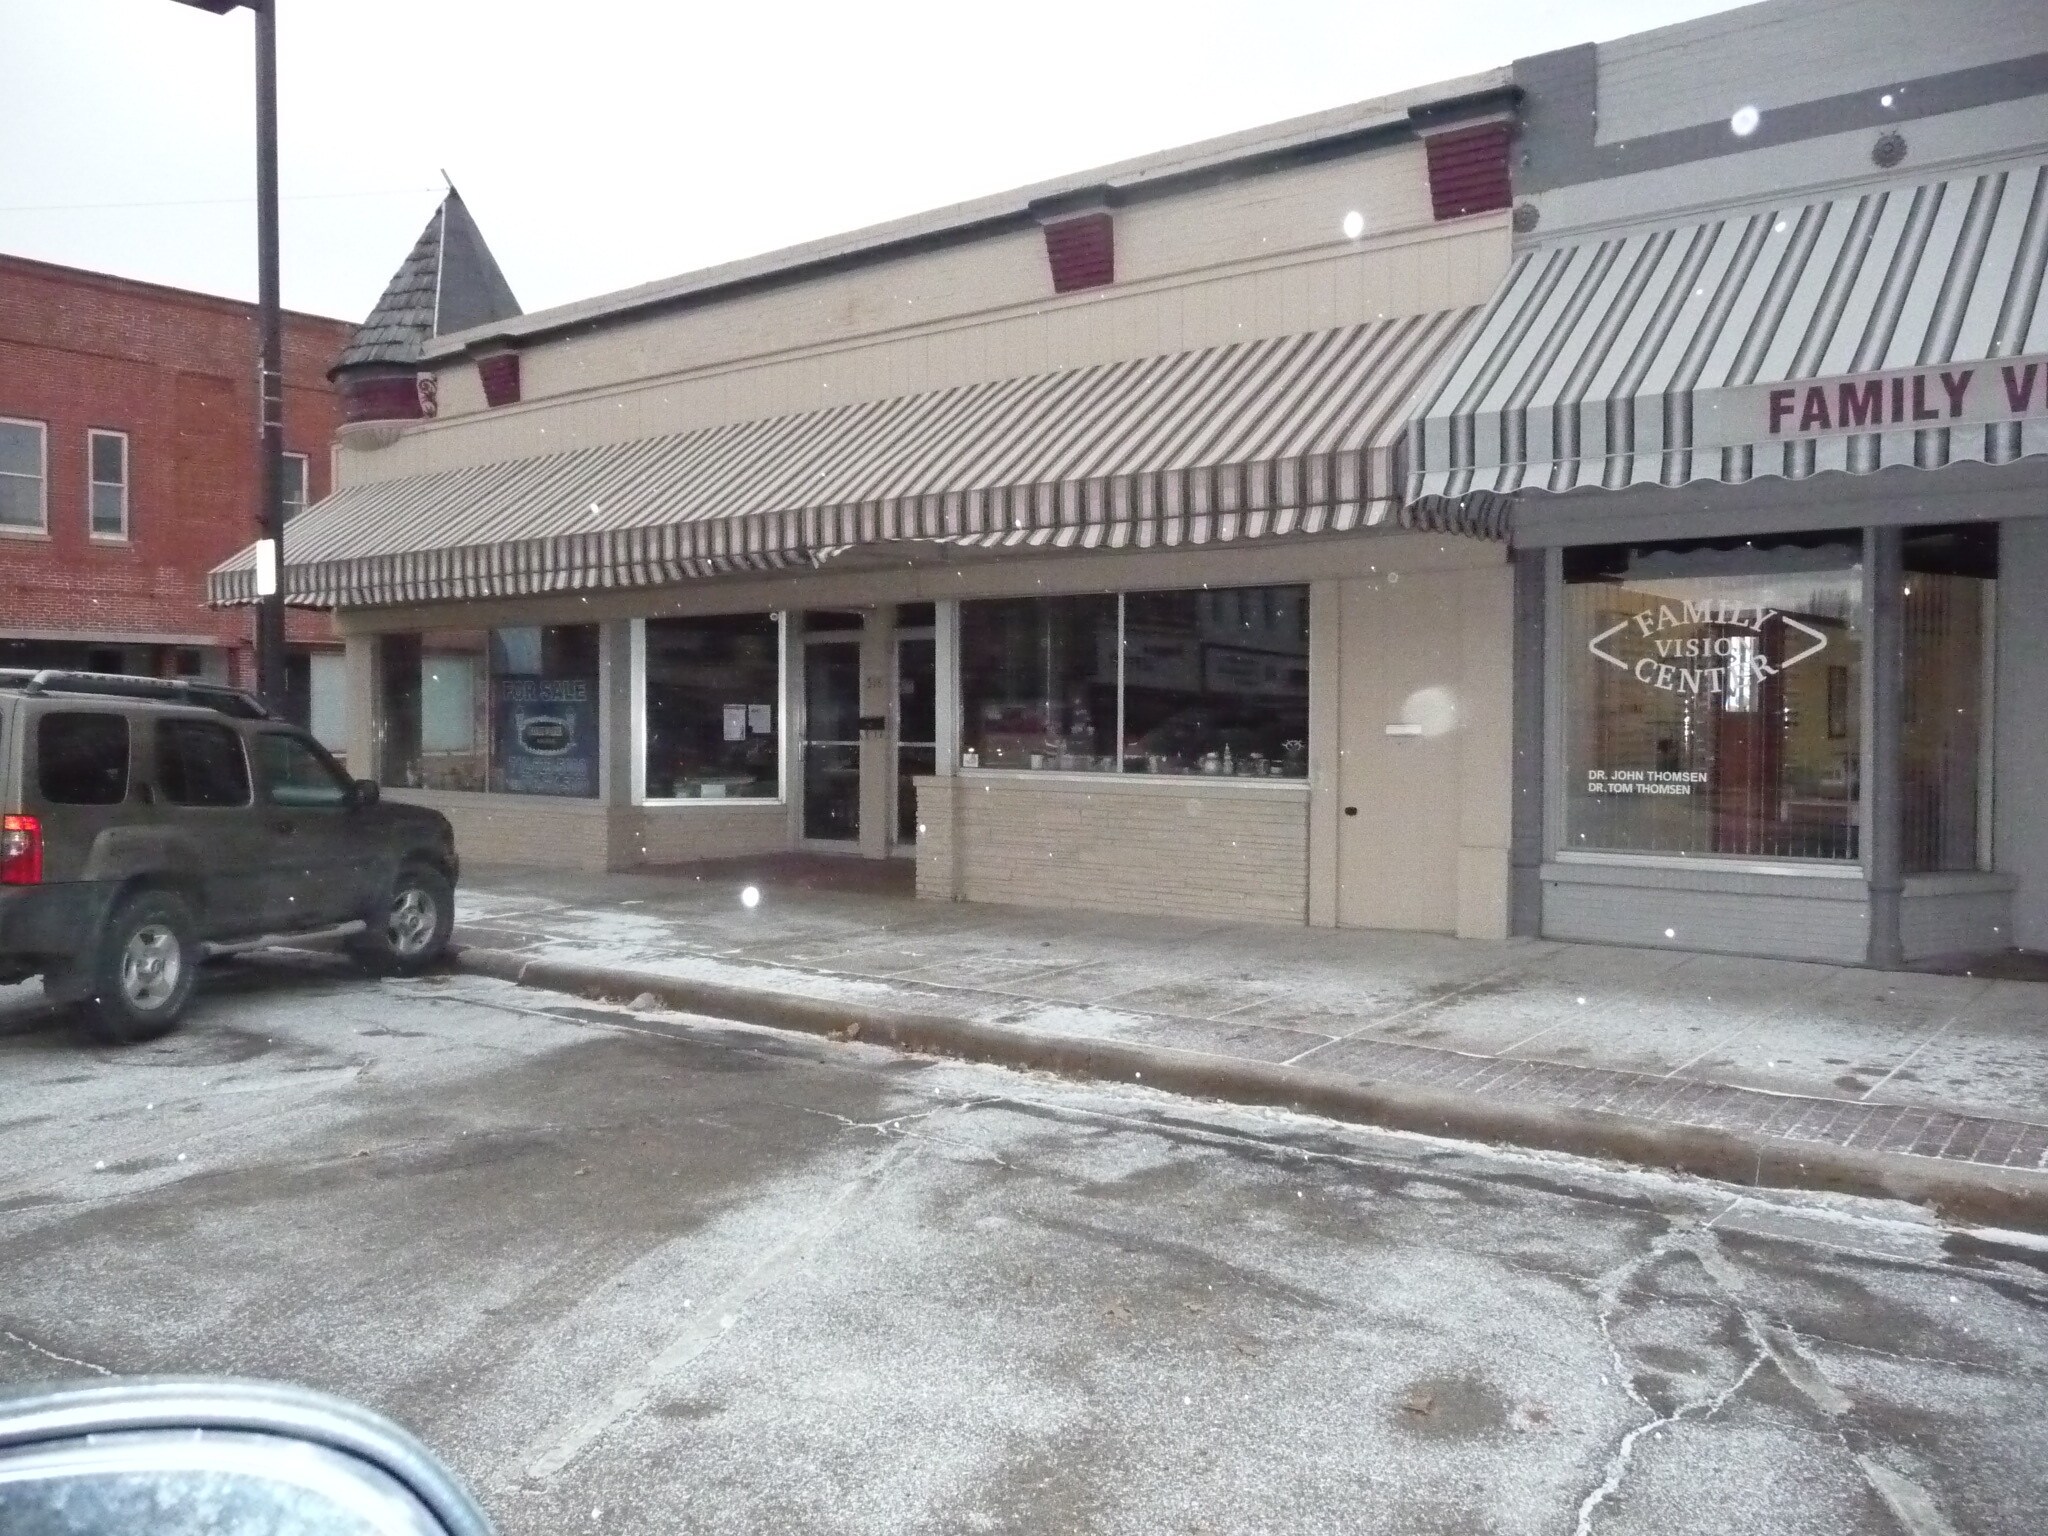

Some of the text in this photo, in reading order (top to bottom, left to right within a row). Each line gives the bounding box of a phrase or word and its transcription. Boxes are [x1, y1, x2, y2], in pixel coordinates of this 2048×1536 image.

[1769, 362, 2048, 434] FAMILY V
[1633, 599, 1778, 638] FAMILY
[1654, 636, 1756, 658] VISION
[504, 680, 587, 701] FOR SALE
[1588, 770, 1708, 783] DR. JOHN THOMSEN
[1607, 783, 1633, 793] TOM
[1636, 783, 1691, 795] THOMSEN
